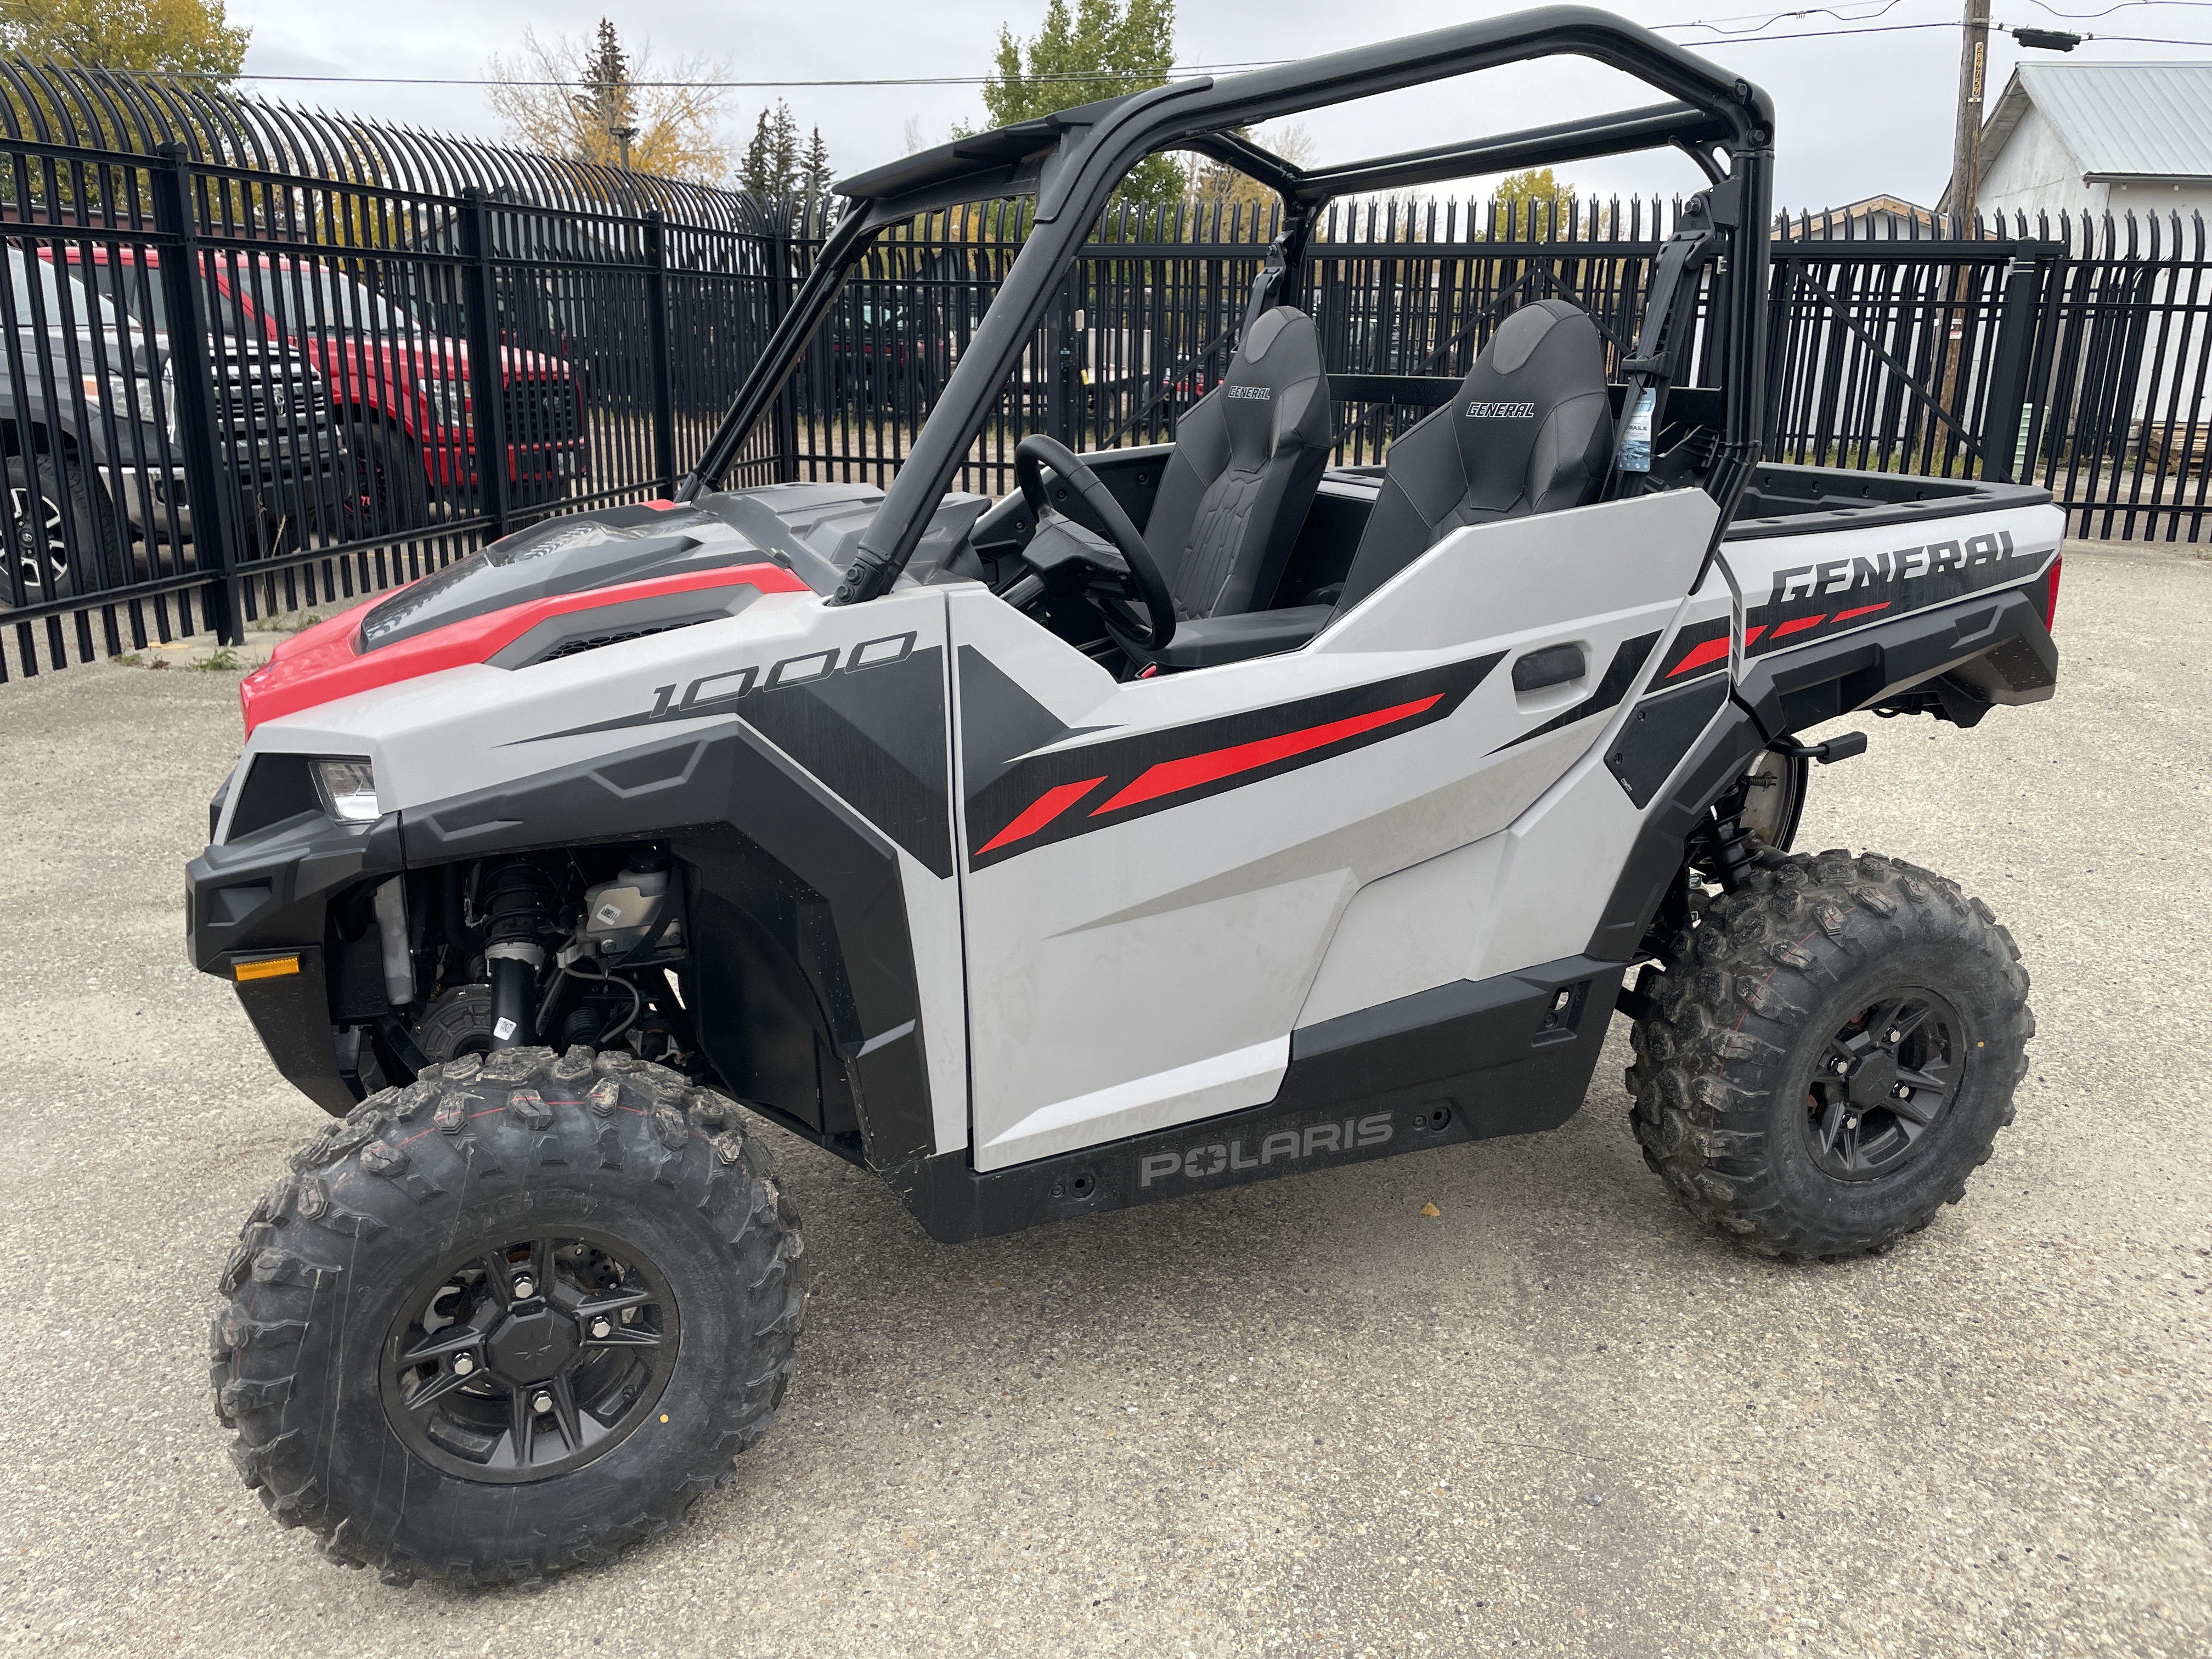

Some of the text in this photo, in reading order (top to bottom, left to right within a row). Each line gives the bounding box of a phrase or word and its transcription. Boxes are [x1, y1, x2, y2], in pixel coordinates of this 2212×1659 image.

[1228, 386, 1270, 400] GENERAL
[1466, 402, 1534, 418] GENERAL
[1771, 530, 2015, 603] GENERAL
[650, 631, 917, 718] 1000
[1141, 1113, 1394, 1187] POLARIS
